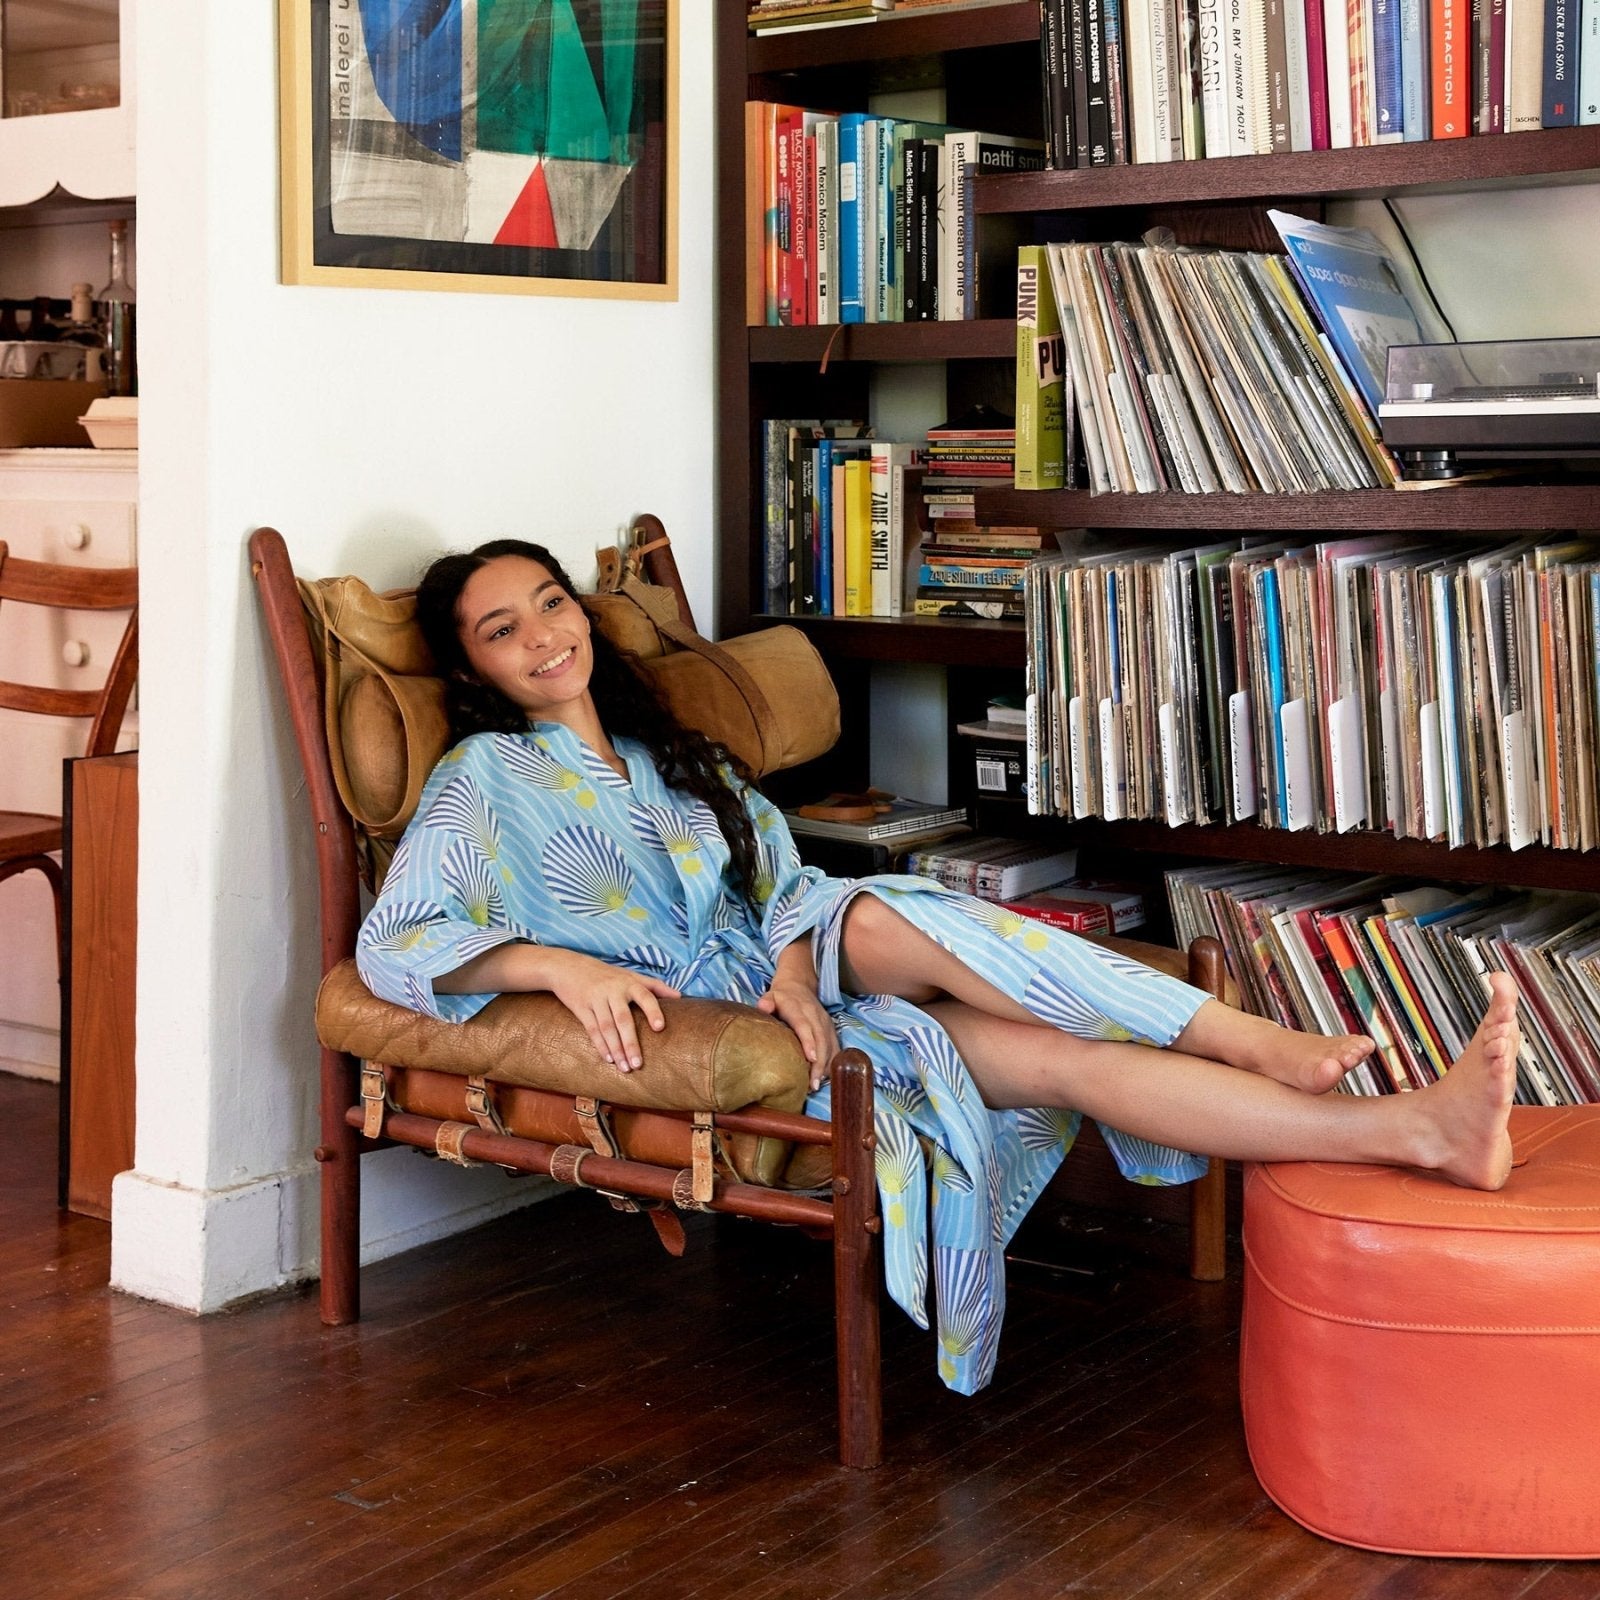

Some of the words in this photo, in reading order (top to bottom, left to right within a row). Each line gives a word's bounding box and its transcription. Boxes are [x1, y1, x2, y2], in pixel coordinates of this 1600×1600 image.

[1557, 6, 1565, 29] SICK
[1074, 26, 1083, 71] TRILOGY
[1090, 22, 1100, 83] EXPOSURES
[1155, 40, 1165, 61] Sun
[1233, 29, 1241, 49] RAY
[1556, 31, 1564, 52] BAG
[336, 24, 349, 116] malerei
[1156, 65, 1168, 96] Anish
[1168, 56, 1176, 92] PAINTINGS
[1234, 53, 1243, 99] JOHNSON
[1555, 53, 1564, 80] SONG
[1157, 100, 1169, 141] Kapoor
[1237, 105, 1246, 142] TAOIST
[779, 135, 788, 177] color
[794, 128, 803, 159] BLACK
[952, 142, 965, 172] patti
[982, 151, 1014, 168] patti
[795, 162, 803, 215] MOUNTAIN
[818, 166, 827, 206] Mexico
[896, 185, 904, 219] MALICK
[906, 178, 914, 204] Sidibé
[957, 176, 965, 211] smith
[795, 218, 804, 260] COLLEGE
[819, 208, 827, 251] Modern
[957, 216, 965, 256] dream
[1018, 268, 1036, 321] PUNK
[871, 456, 888, 475] NW
[871, 492, 888, 525] ZADIE
[871, 530, 888, 570] SMITH
[981, 572, 1000, 585] FEEL
[1001, 573, 1021, 585] FREE
